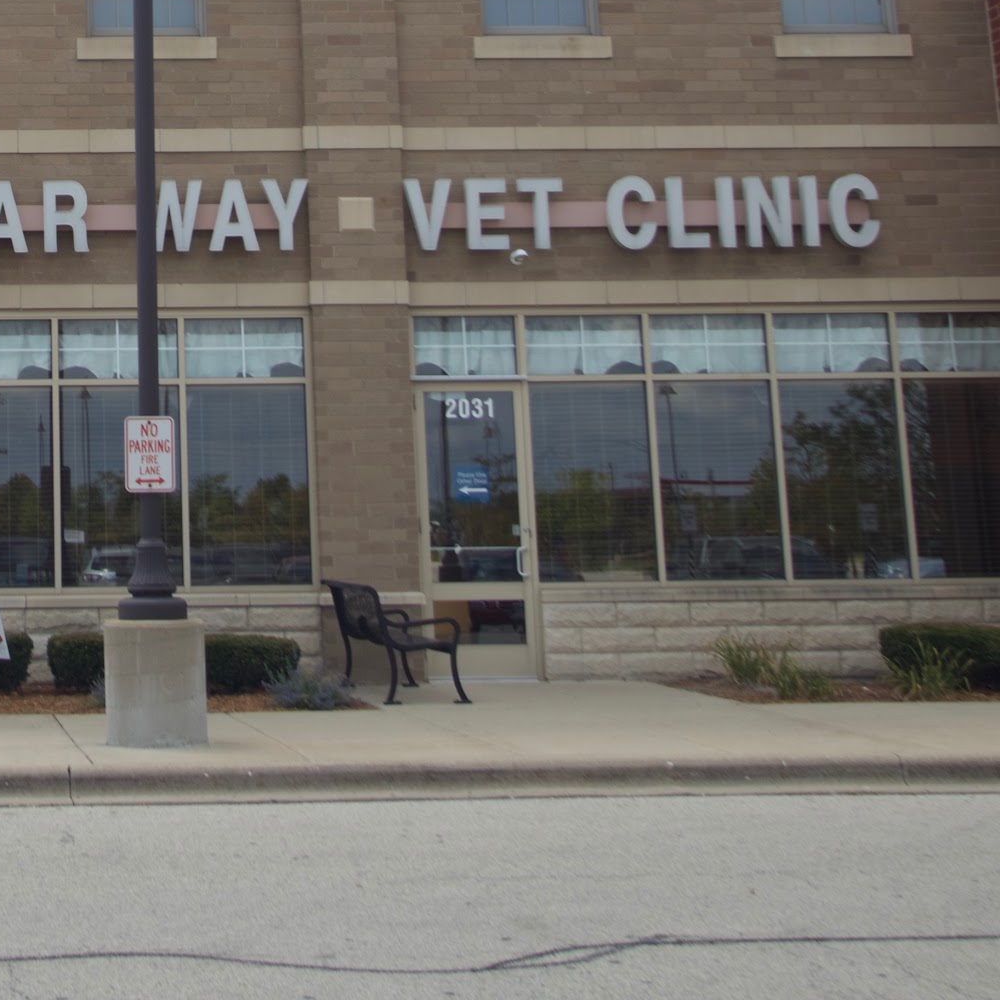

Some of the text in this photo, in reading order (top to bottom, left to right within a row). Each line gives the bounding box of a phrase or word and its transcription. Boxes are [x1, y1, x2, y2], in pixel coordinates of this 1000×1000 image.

[155, 179, 309, 252] WAY
[403, 177, 563, 250] VET
[606, 173, 881, 250] CLINIC
[445, 398, 494, 418] 2031
[141, 424, 158, 437] NO
[129, 440, 171, 453] PARKING
[141, 455, 159, 464] FIRE
[140, 466, 161, 475] LANE
